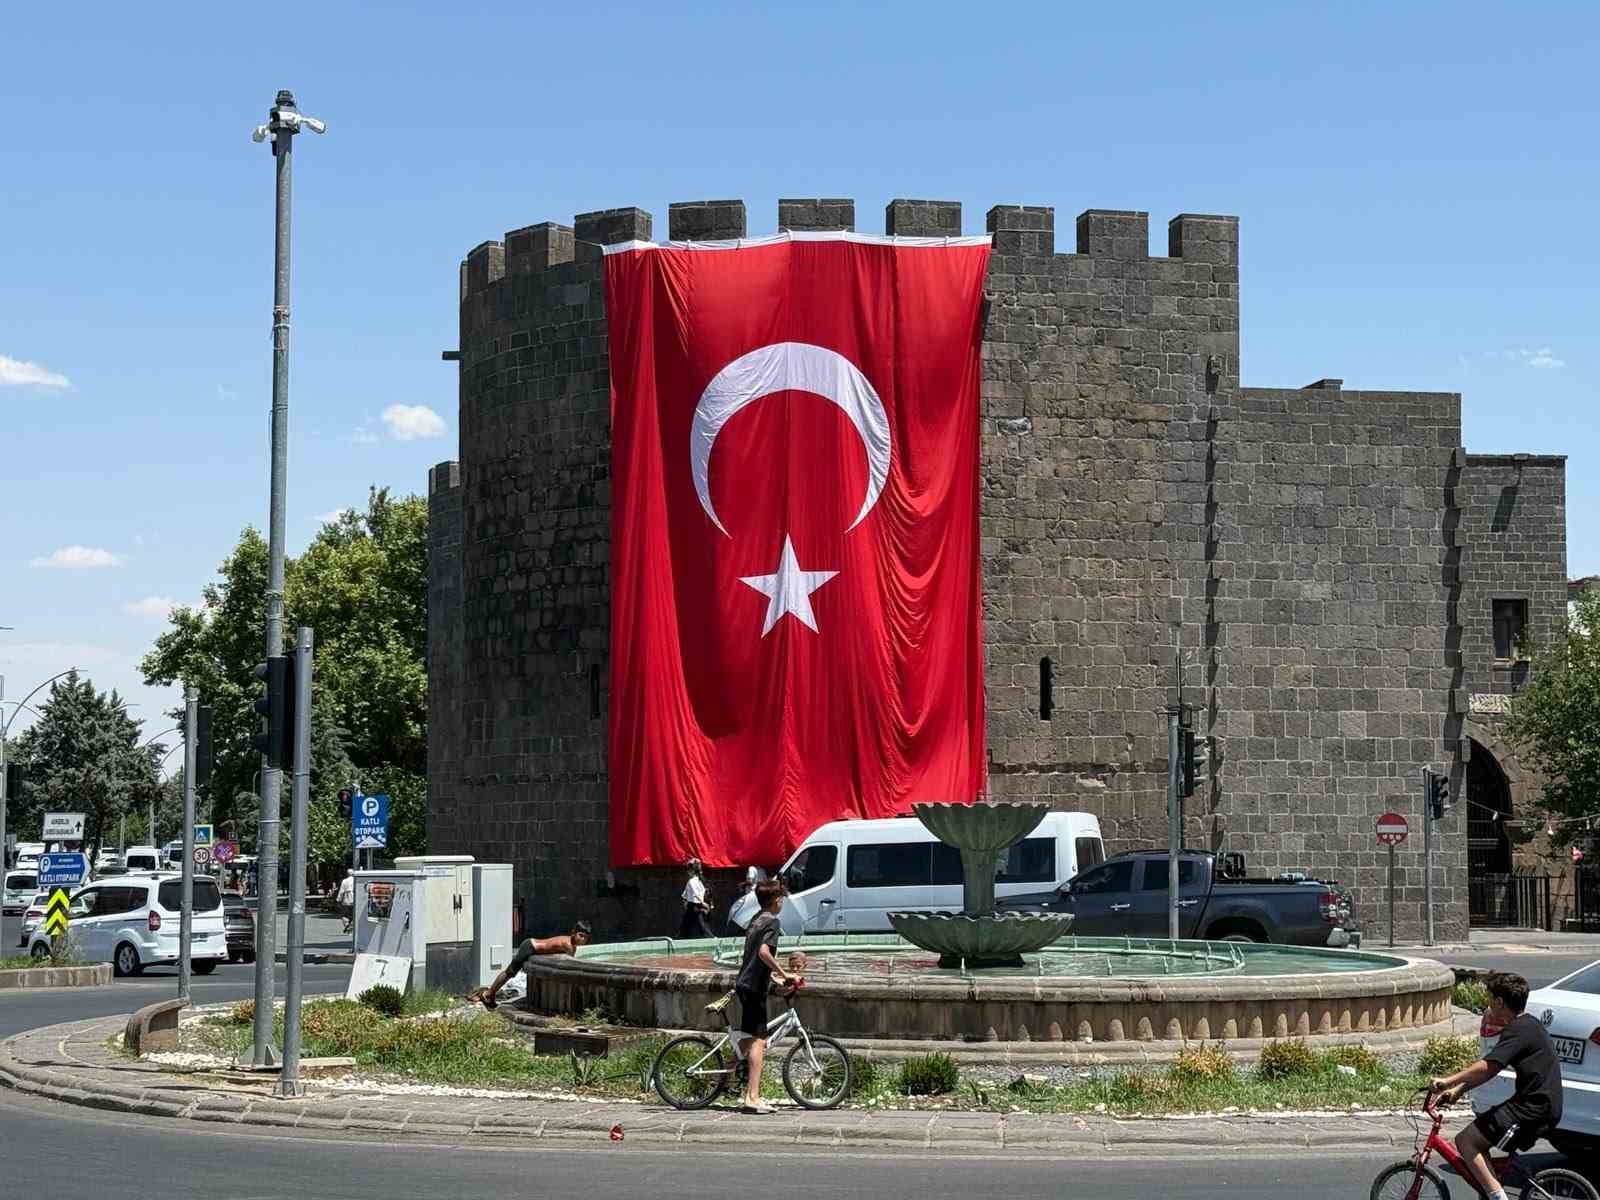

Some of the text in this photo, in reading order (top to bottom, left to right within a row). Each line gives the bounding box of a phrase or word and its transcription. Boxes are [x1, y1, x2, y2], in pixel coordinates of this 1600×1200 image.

[366, 801, 377, 814] P
[355, 827, 385, 835] OTOPARK
[195, 851, 206, 861] 30
